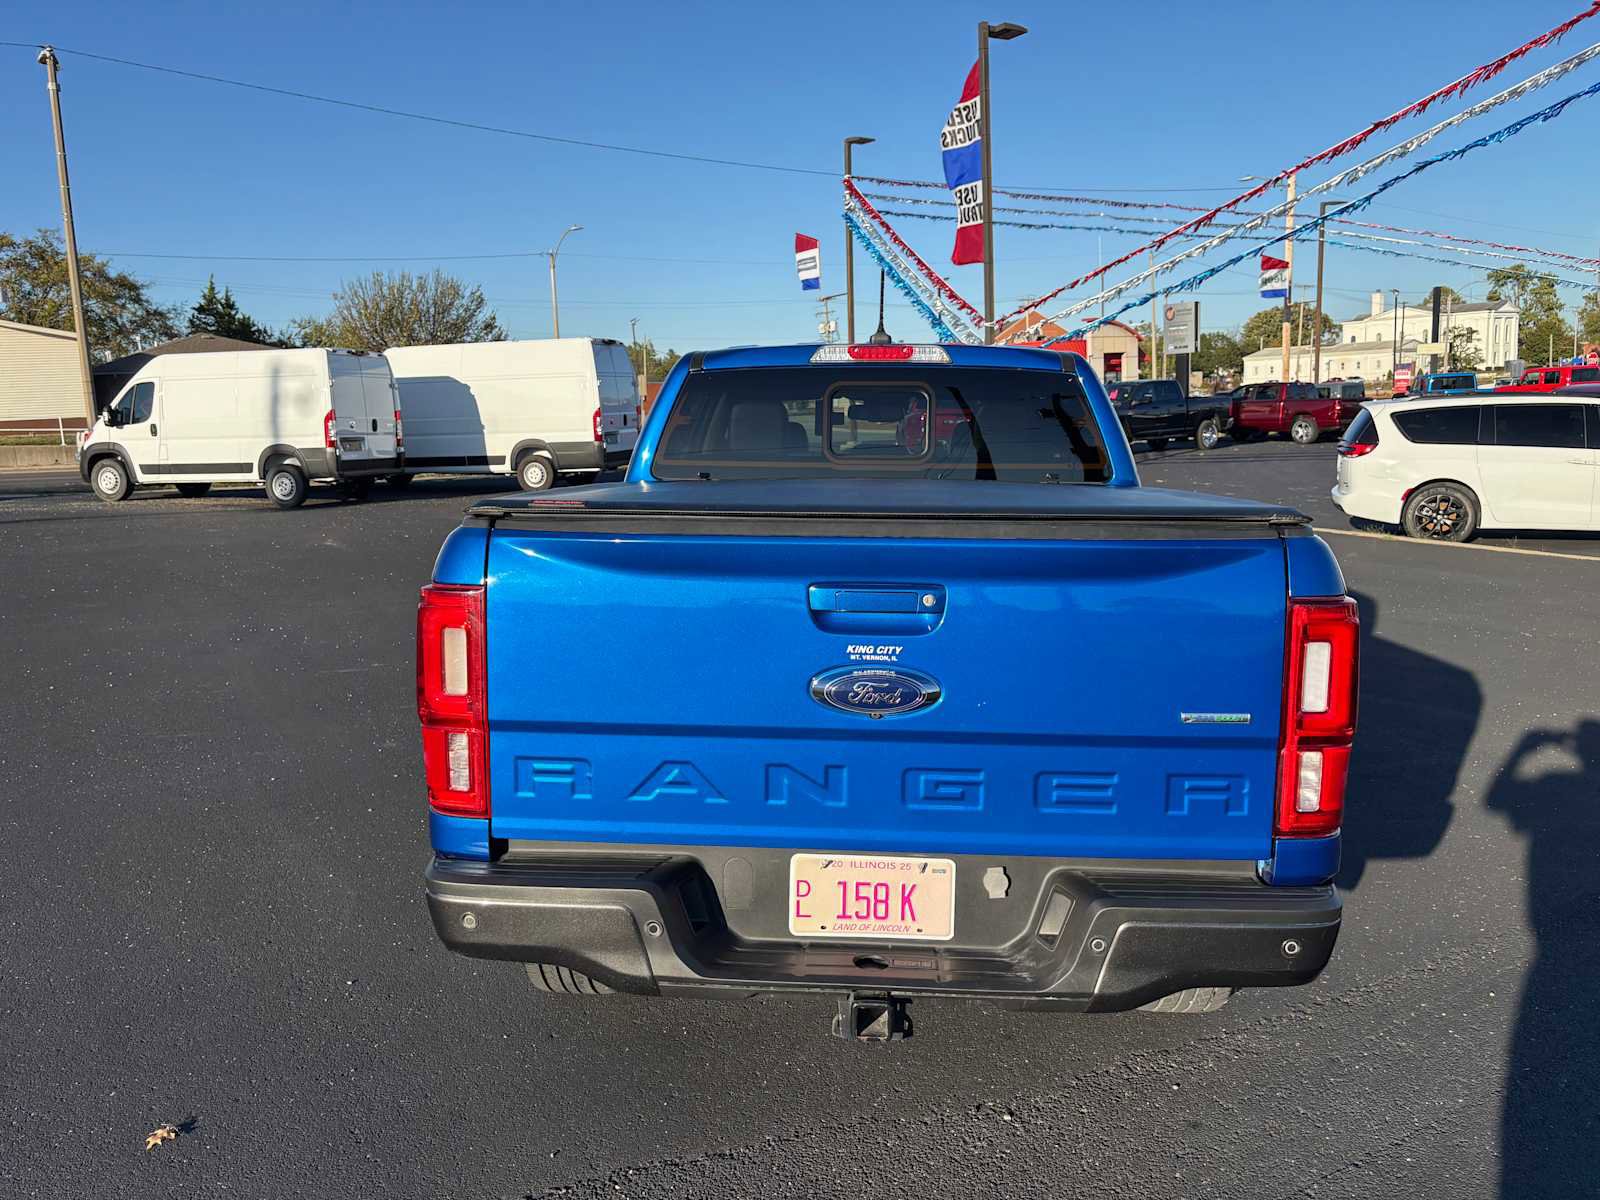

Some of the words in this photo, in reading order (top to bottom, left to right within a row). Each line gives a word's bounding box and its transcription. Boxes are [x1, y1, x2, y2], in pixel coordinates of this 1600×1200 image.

[846, 645, 874, 654] KING
[876, 645, 903, 655] CITY
[848, 681, 903, 705] Ford
[514, 756, 1251, 817] RANGER
[850, 861, 897, 870] ILLINOIS
[836, 880, 889, 920] 158
[900, 883, 917, 922] K
[833, 922, 857, 931] LAND
[858, 923, 870, 931] OF
[872, 924, 912, 933] LINCOLN
